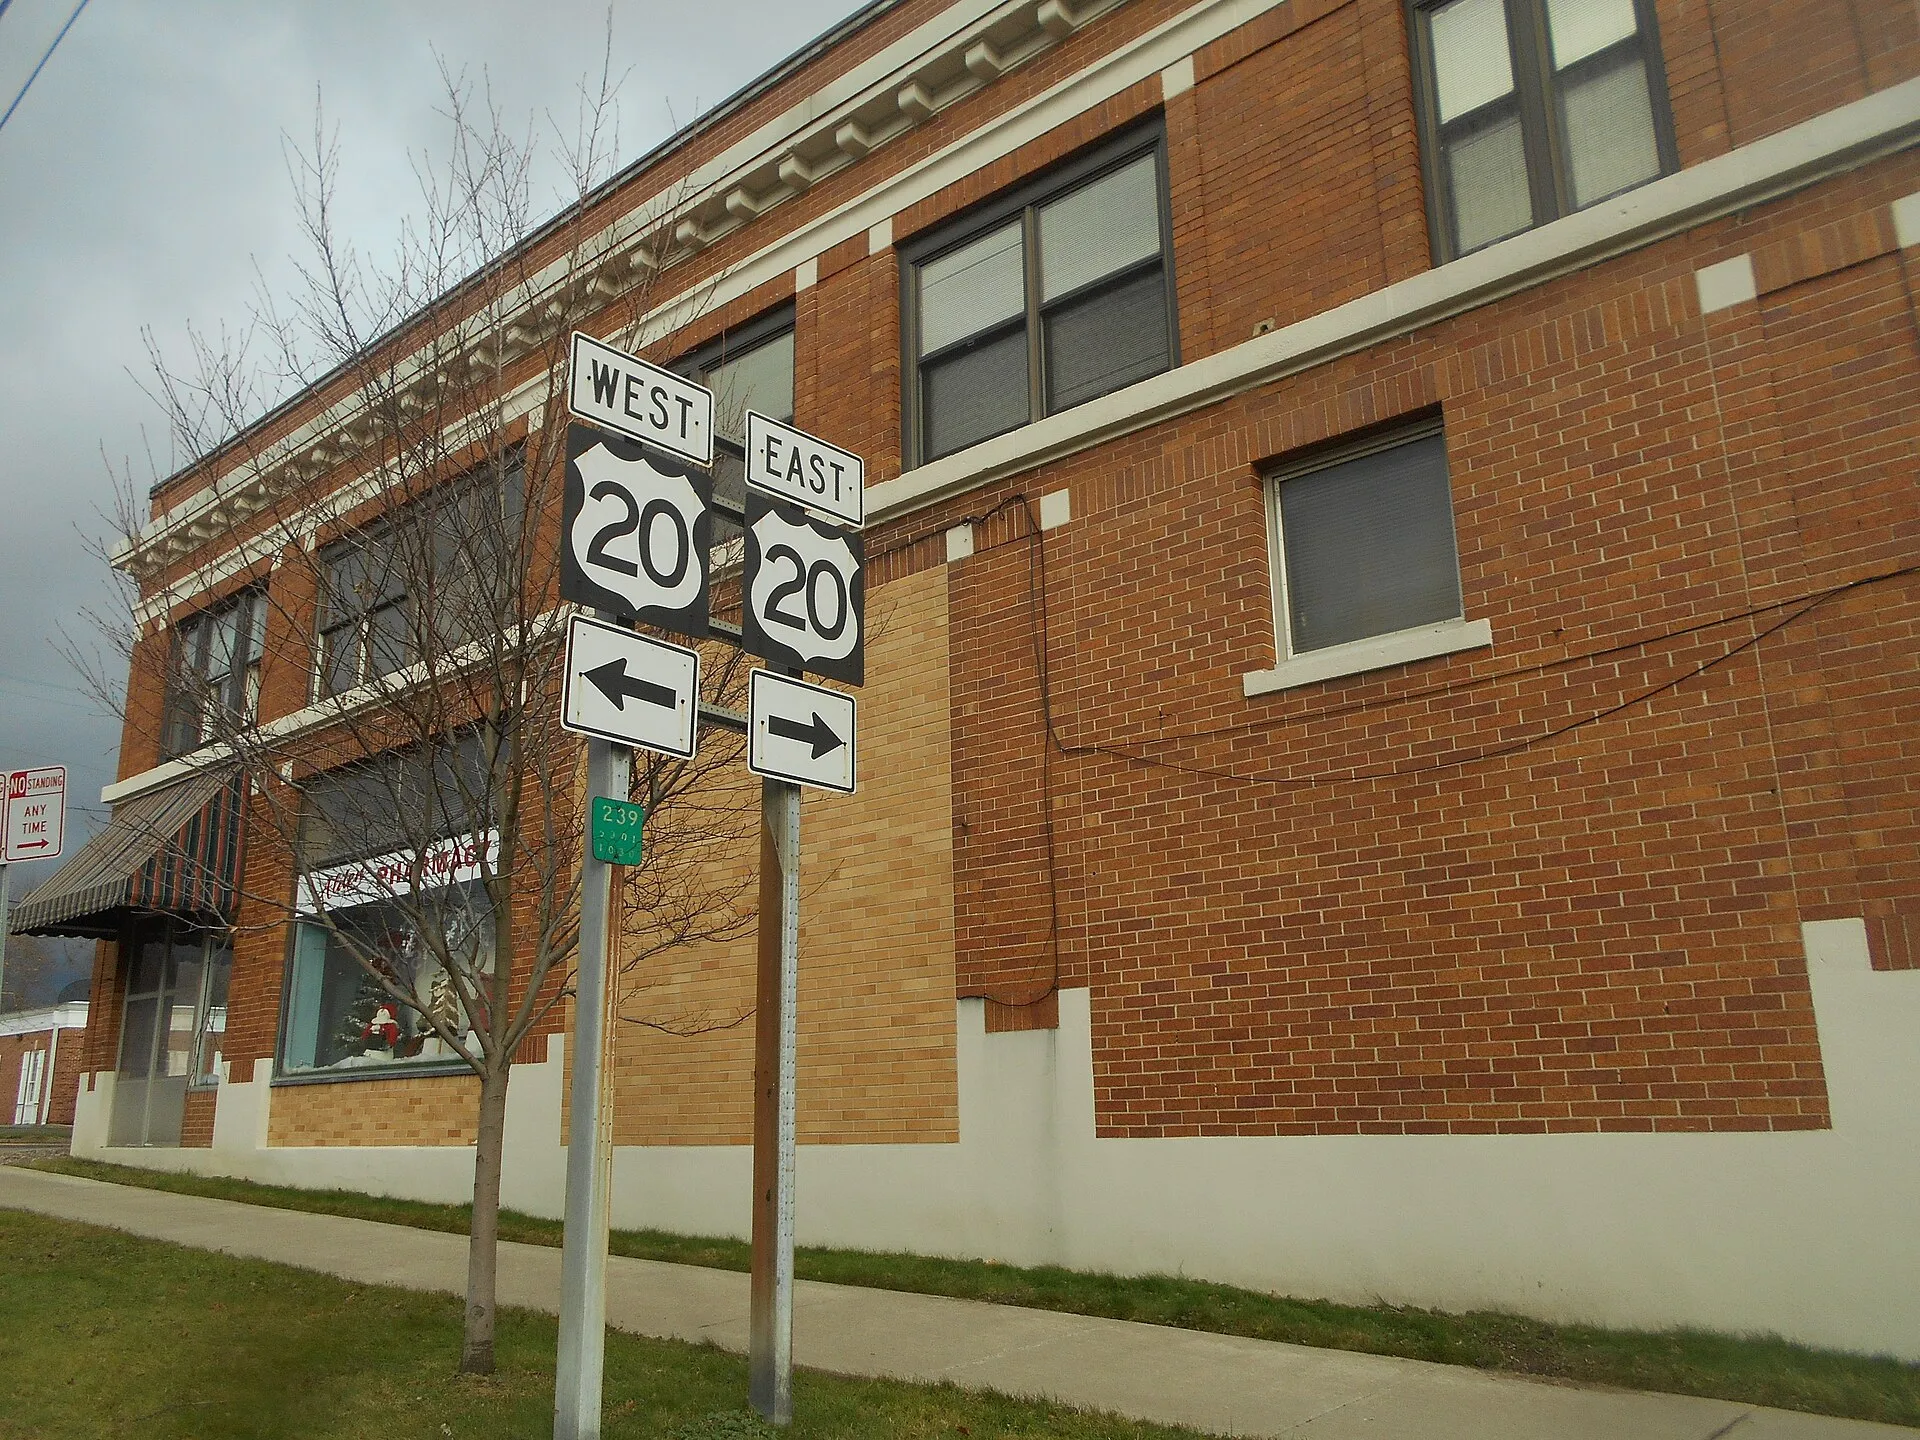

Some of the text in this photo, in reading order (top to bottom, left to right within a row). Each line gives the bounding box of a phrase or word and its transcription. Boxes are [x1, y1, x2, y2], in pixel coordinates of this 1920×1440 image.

[591, 358, 693, 439] WEST
[765, 433, 845, 502] EAST
[586, 480, 690, 588] 20
[763, 543, 848, 641] 20
[10, 776, 26, 795] NO
[27, 775, 63, 790] STANDING
[22, 820, 48, 835] TIME
[24, 804, 47, 818] ANY
[602, 805, 638, 826] 239
